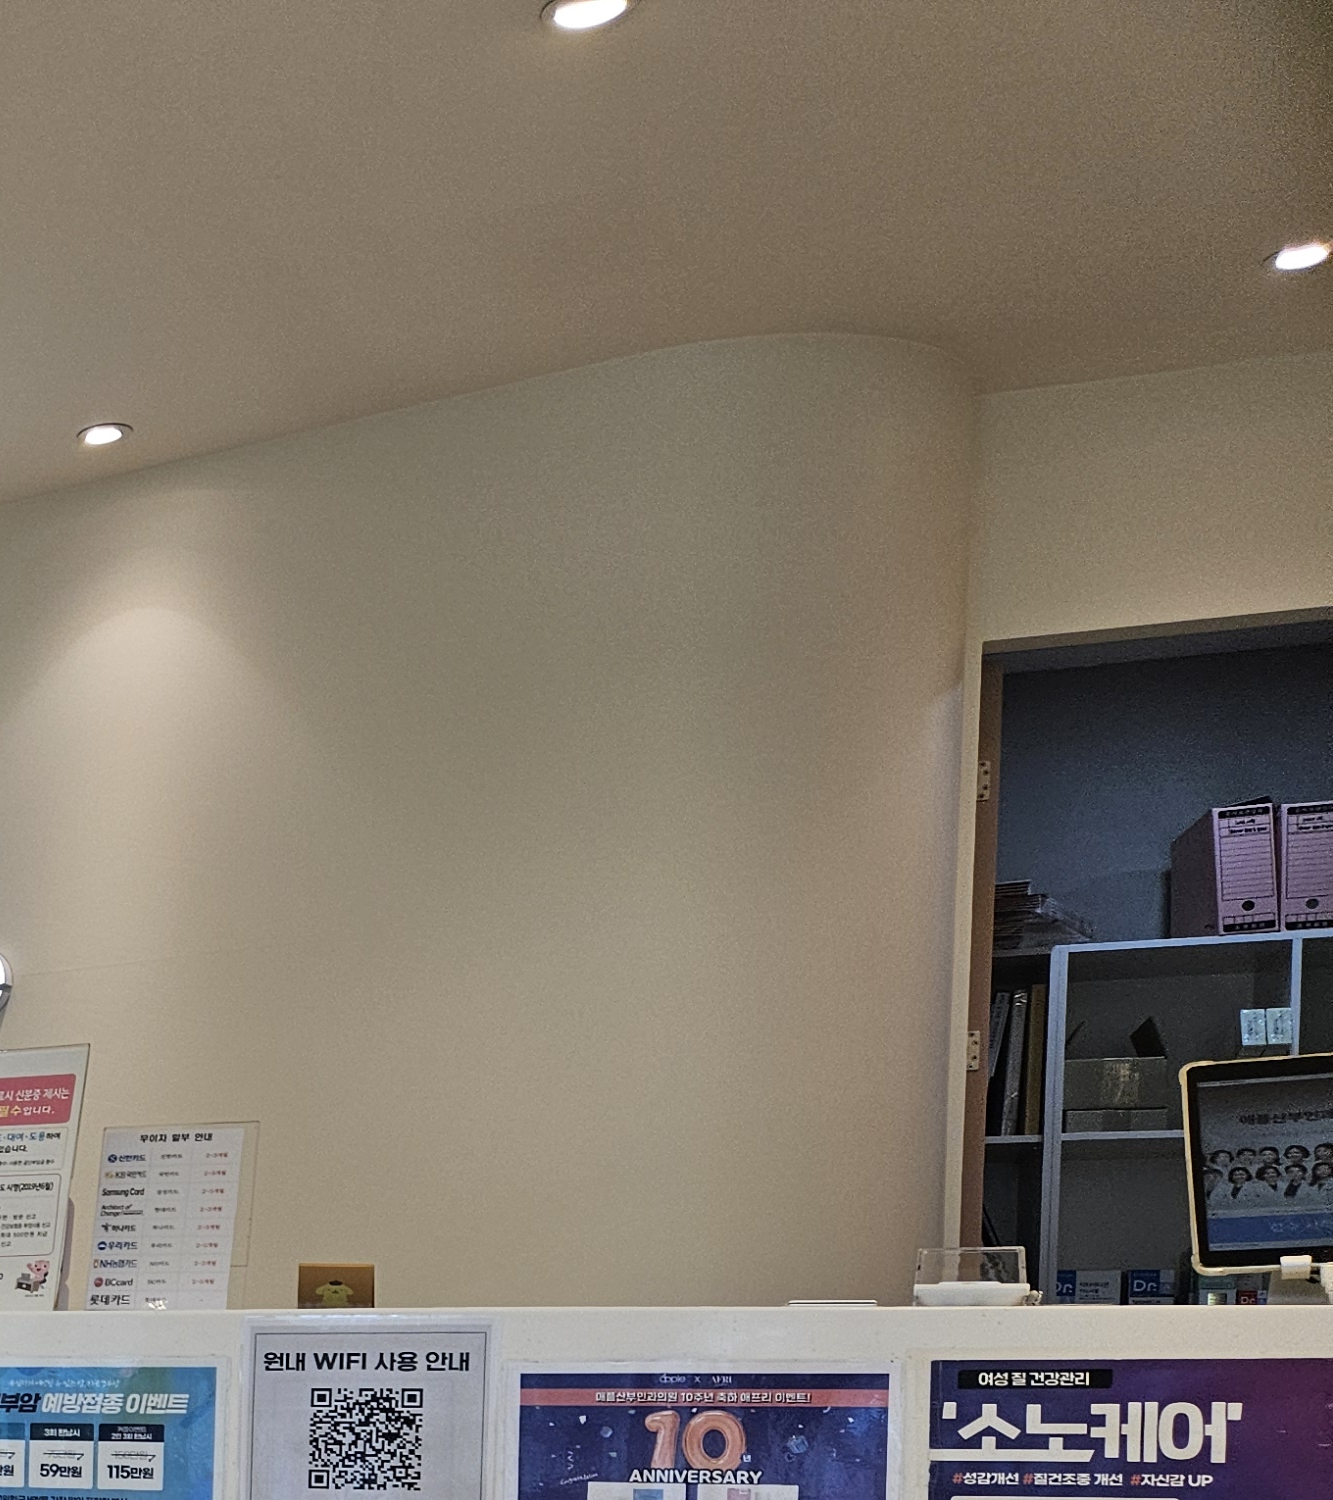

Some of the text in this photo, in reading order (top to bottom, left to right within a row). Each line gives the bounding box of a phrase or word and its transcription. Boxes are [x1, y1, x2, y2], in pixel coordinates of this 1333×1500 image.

[16, 1089, 41, 1101] 신분증
[43, 1087, 70, 1099] 제시는
[140, 1132, 213, 1143] 무이자 안내
[102, 1188, 129, 1197] Samsung
[108, 1241, 138, 1250] 우리카드
[90, 1294, 130, 1306] 롯데카드
[263, 1351, 470, 1372] 원내 WIFI 사용 안내
[978, 1371, 1090, 1387] 여성 질 건강관리
[41, 1392, 124, 1414] 예방접종
[125, 1393, 190, 1415] 이벤트
[644, 1409, 747, 1470] 10
[39, 1463, 82, 1478] 59만원
[107, 1464, 154, 1480] 115만원
[629, 1469, 762, 1484] ANNIVERSARY
